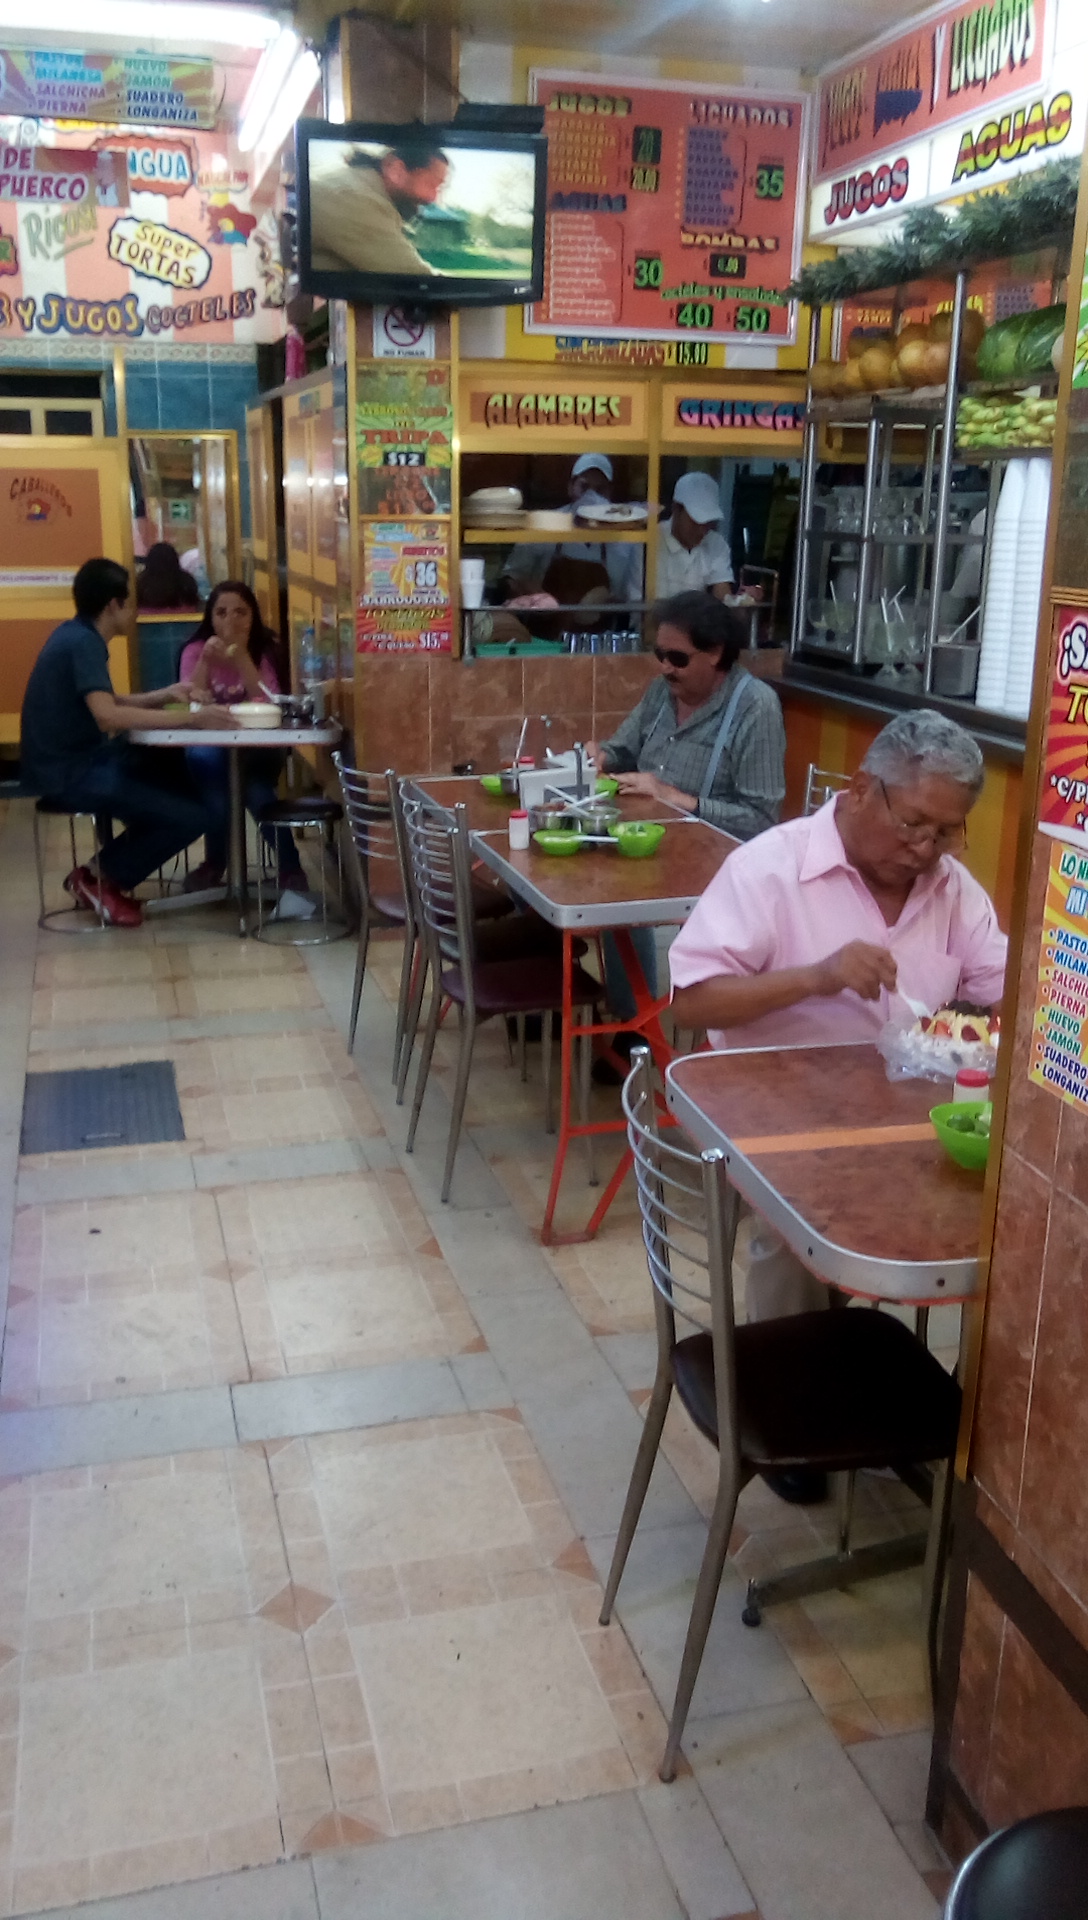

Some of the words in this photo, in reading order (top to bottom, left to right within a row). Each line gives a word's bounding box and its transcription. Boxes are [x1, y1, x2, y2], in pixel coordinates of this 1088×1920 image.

[37, 83, 106, 98] SALCHICHA
[127, 90, 184, 105] SUADERO
[38, 99, 87, 113] PIERNA
[127, 106, 198, 121] LONGANIZA
[3, 149, 32, 170] DE
[0, 173, 86, 201] PUERCO
[757, 167, 784, 198] 35
[824, 157, 910, 225] JUGOS
[137, 225, 197, 258] Super
[116, 234, 197, 285] TORTAS
[634, 258, 663, 289] 30
[17, 298, 36, 331] Y
[38, 293, 144, 337] JUGOS
[146, 288, 256, 334] COCTELES
[678, 303, 713, 330] 40
[736, 305, 770, 332] 50
[486, 393, 622, 430] ALAMBRES
[360, 429, 450, 445] TRIPA
[1061, 853, 1076, 875] LO
[1057, 929, 1088, 957] PASTO
[1054, 950, 1088, 977] MILAN
[1050, 988, 1087, 1018] PIERNA
[1048, 1008, 1081, 1035] HUEVO
[1044, 1046, 1087, 1080] SUADERO
